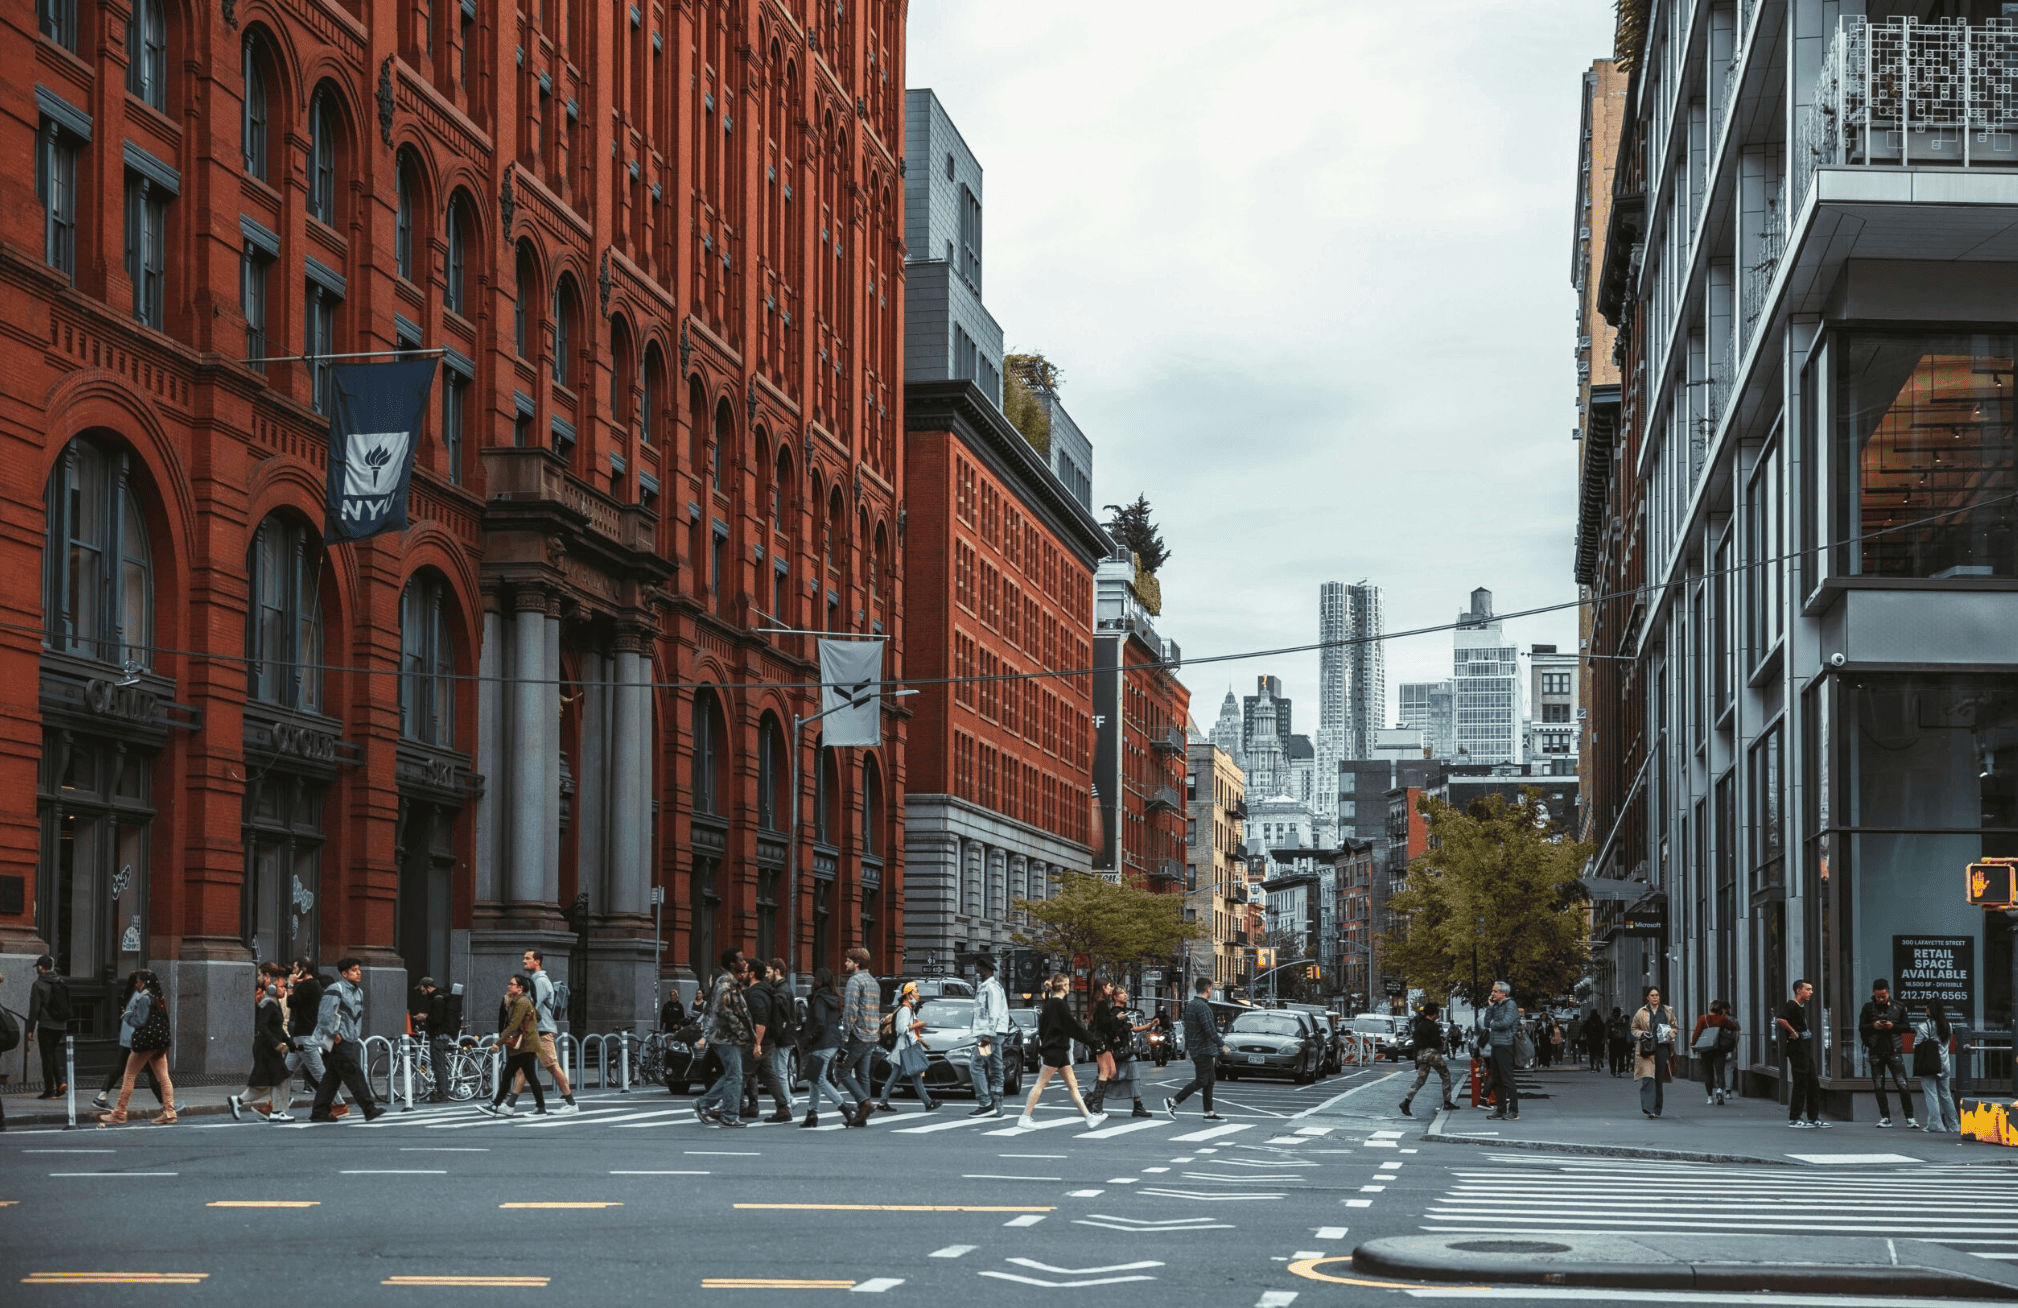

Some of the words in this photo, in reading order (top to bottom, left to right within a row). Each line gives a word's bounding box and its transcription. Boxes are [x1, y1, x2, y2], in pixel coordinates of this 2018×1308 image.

[341, 492, 396, 521] NYU
[427, 759, 455, 788] SKI
[1914, 949, 1954, 958] RETAIL
[1914, 959, 1953, 969] SPACE
[1902, 969, 1967, 979] AVAILABLE
[1901, 991, 1968, 1000] 212.750.6565
